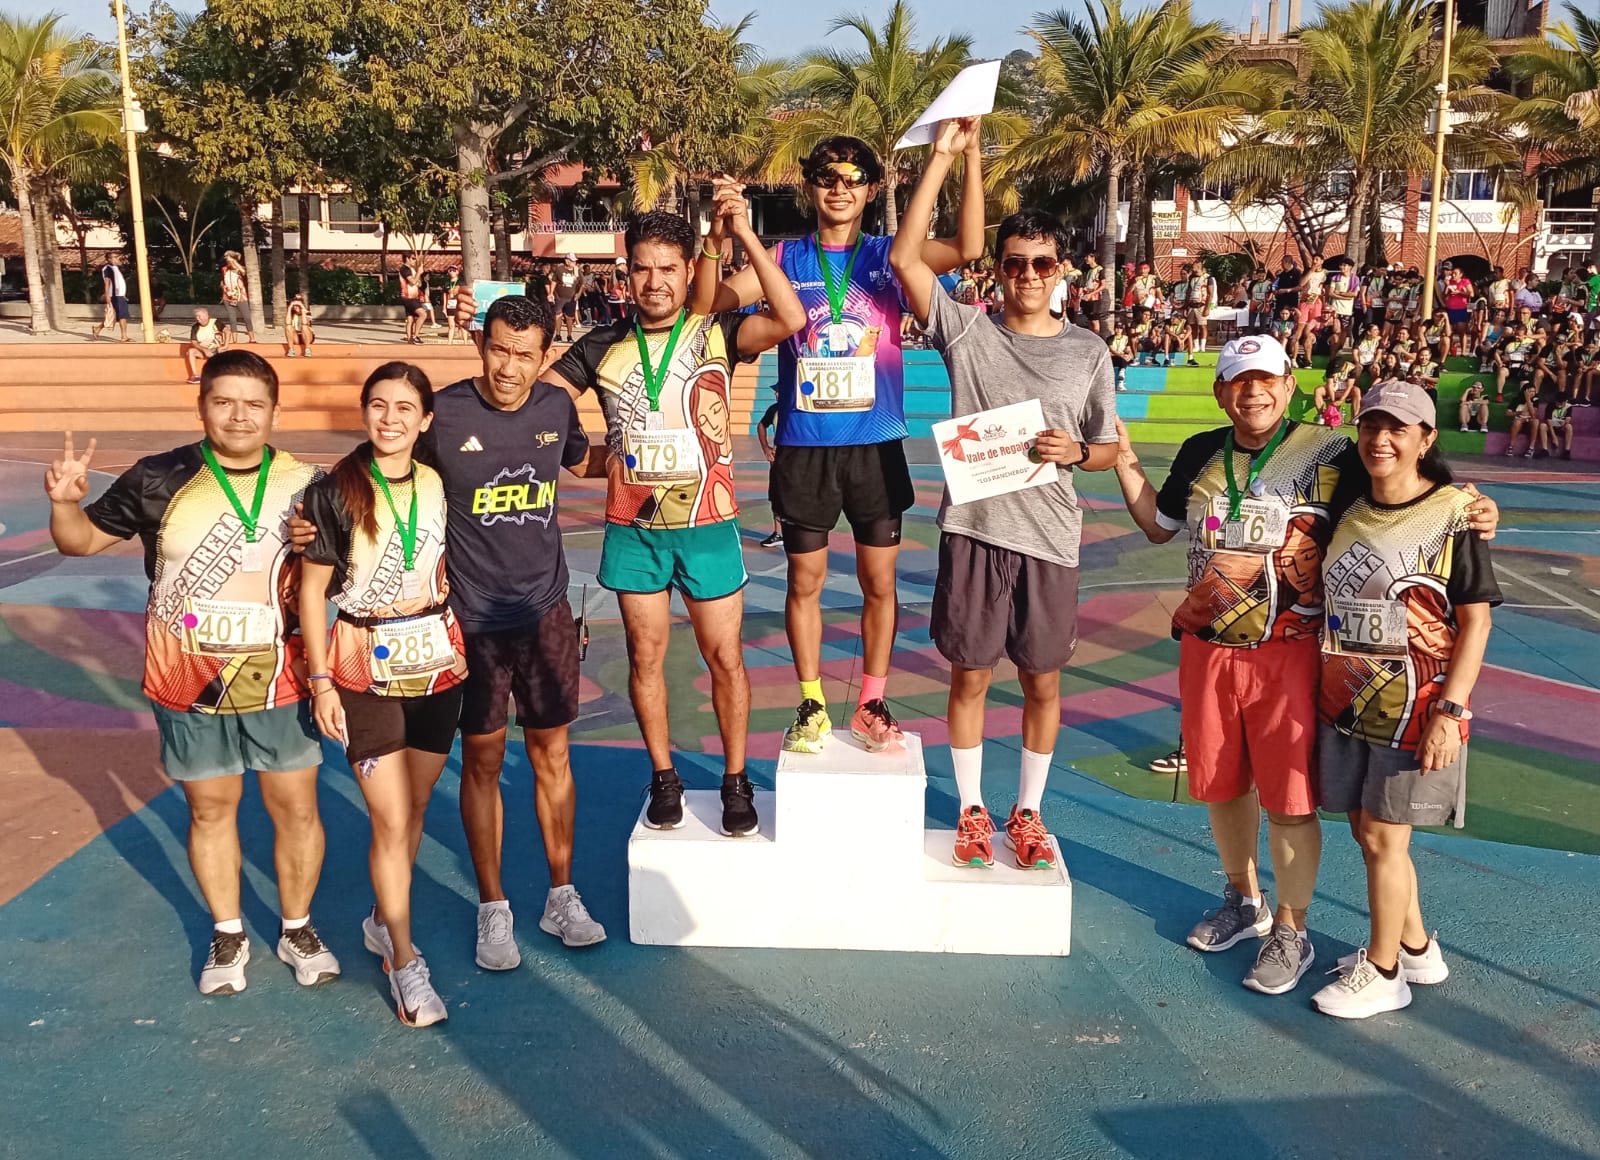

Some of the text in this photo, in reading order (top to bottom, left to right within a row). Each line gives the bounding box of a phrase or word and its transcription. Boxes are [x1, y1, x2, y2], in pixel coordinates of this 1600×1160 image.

[813, 371, 852, 398] 181
[635, 444, 677, 471] 179
[966, 441, 1030, 463] Vale de Regalo
[472, 480, 556, 514] BERLIN
[1264, 537, 1279, 545] 5K
[174, 512, 243, 598] CARRERA
[198, 615, 247, 642] 401
[1339, 612, 1383, 643] 478
[387, 632, 434, 664] 285
